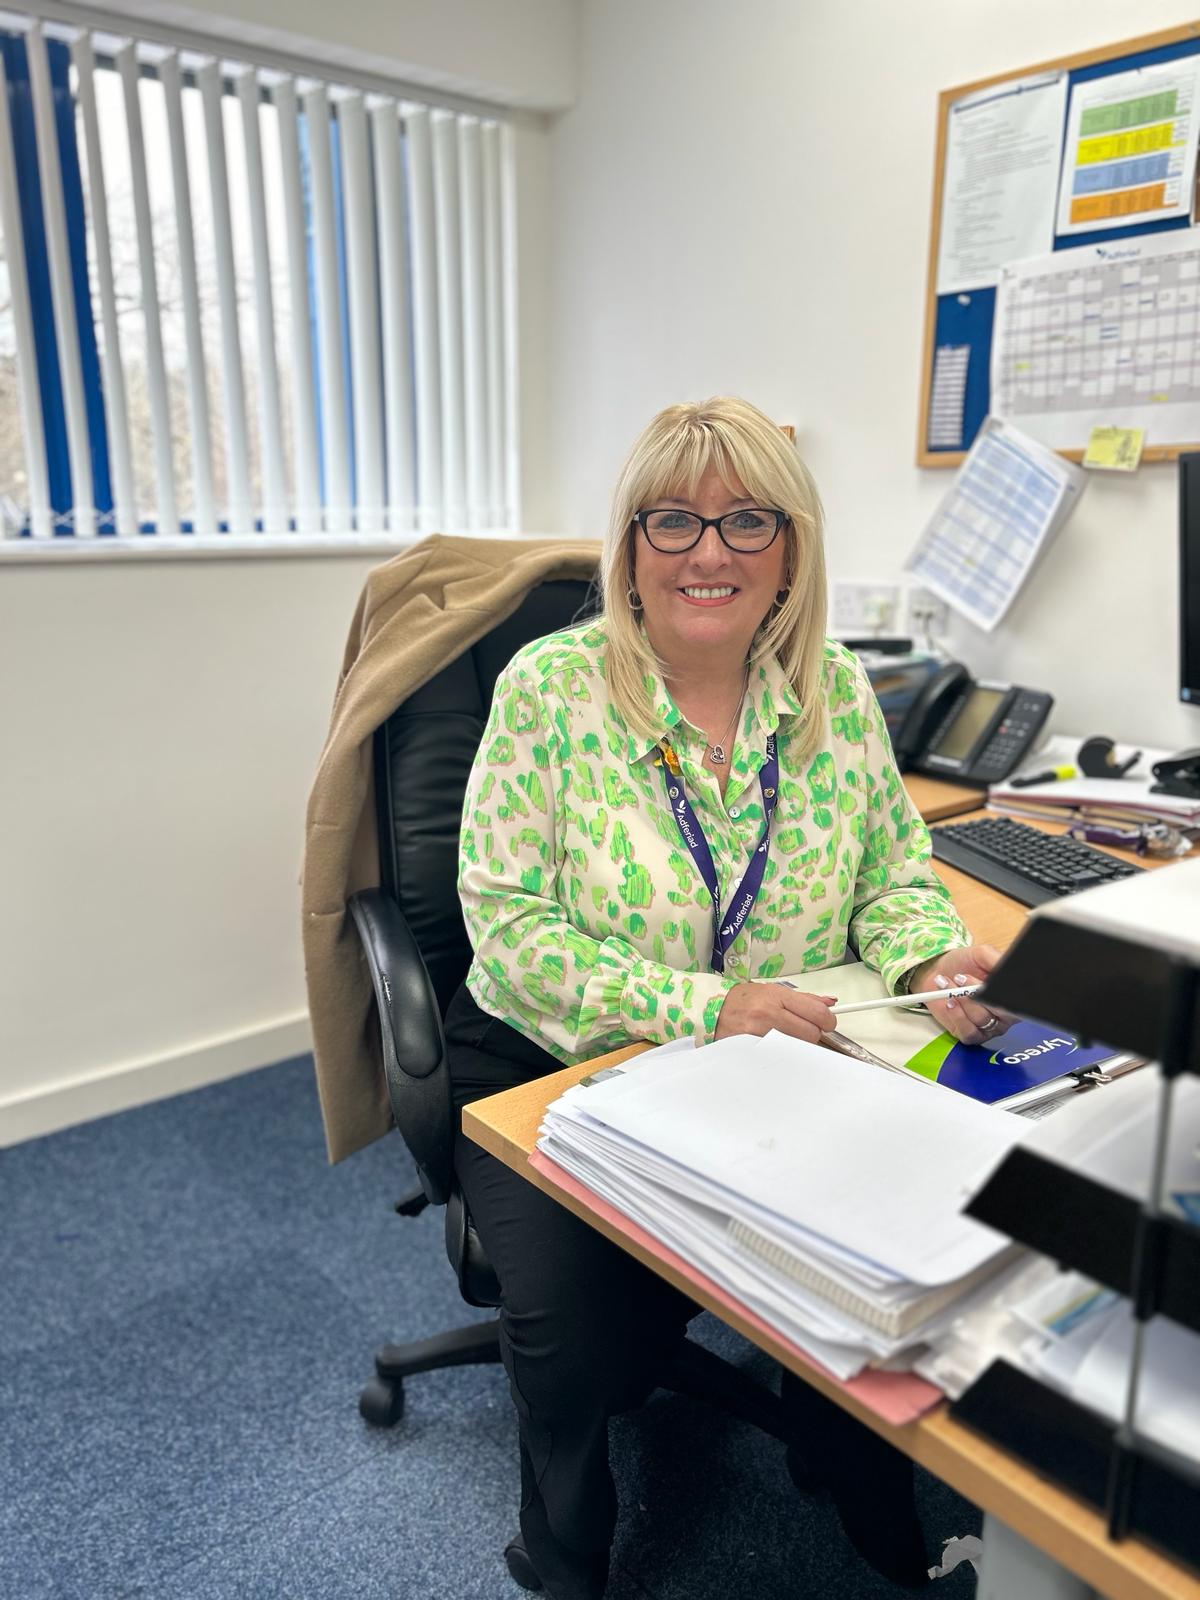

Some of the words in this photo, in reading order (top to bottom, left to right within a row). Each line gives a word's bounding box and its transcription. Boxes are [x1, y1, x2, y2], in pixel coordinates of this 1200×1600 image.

[677, 815, 699, 849] Adferiad
[733, 893, 753, 929] Adferiad
[1003, 1037, 1073, 1065] Lyreco
